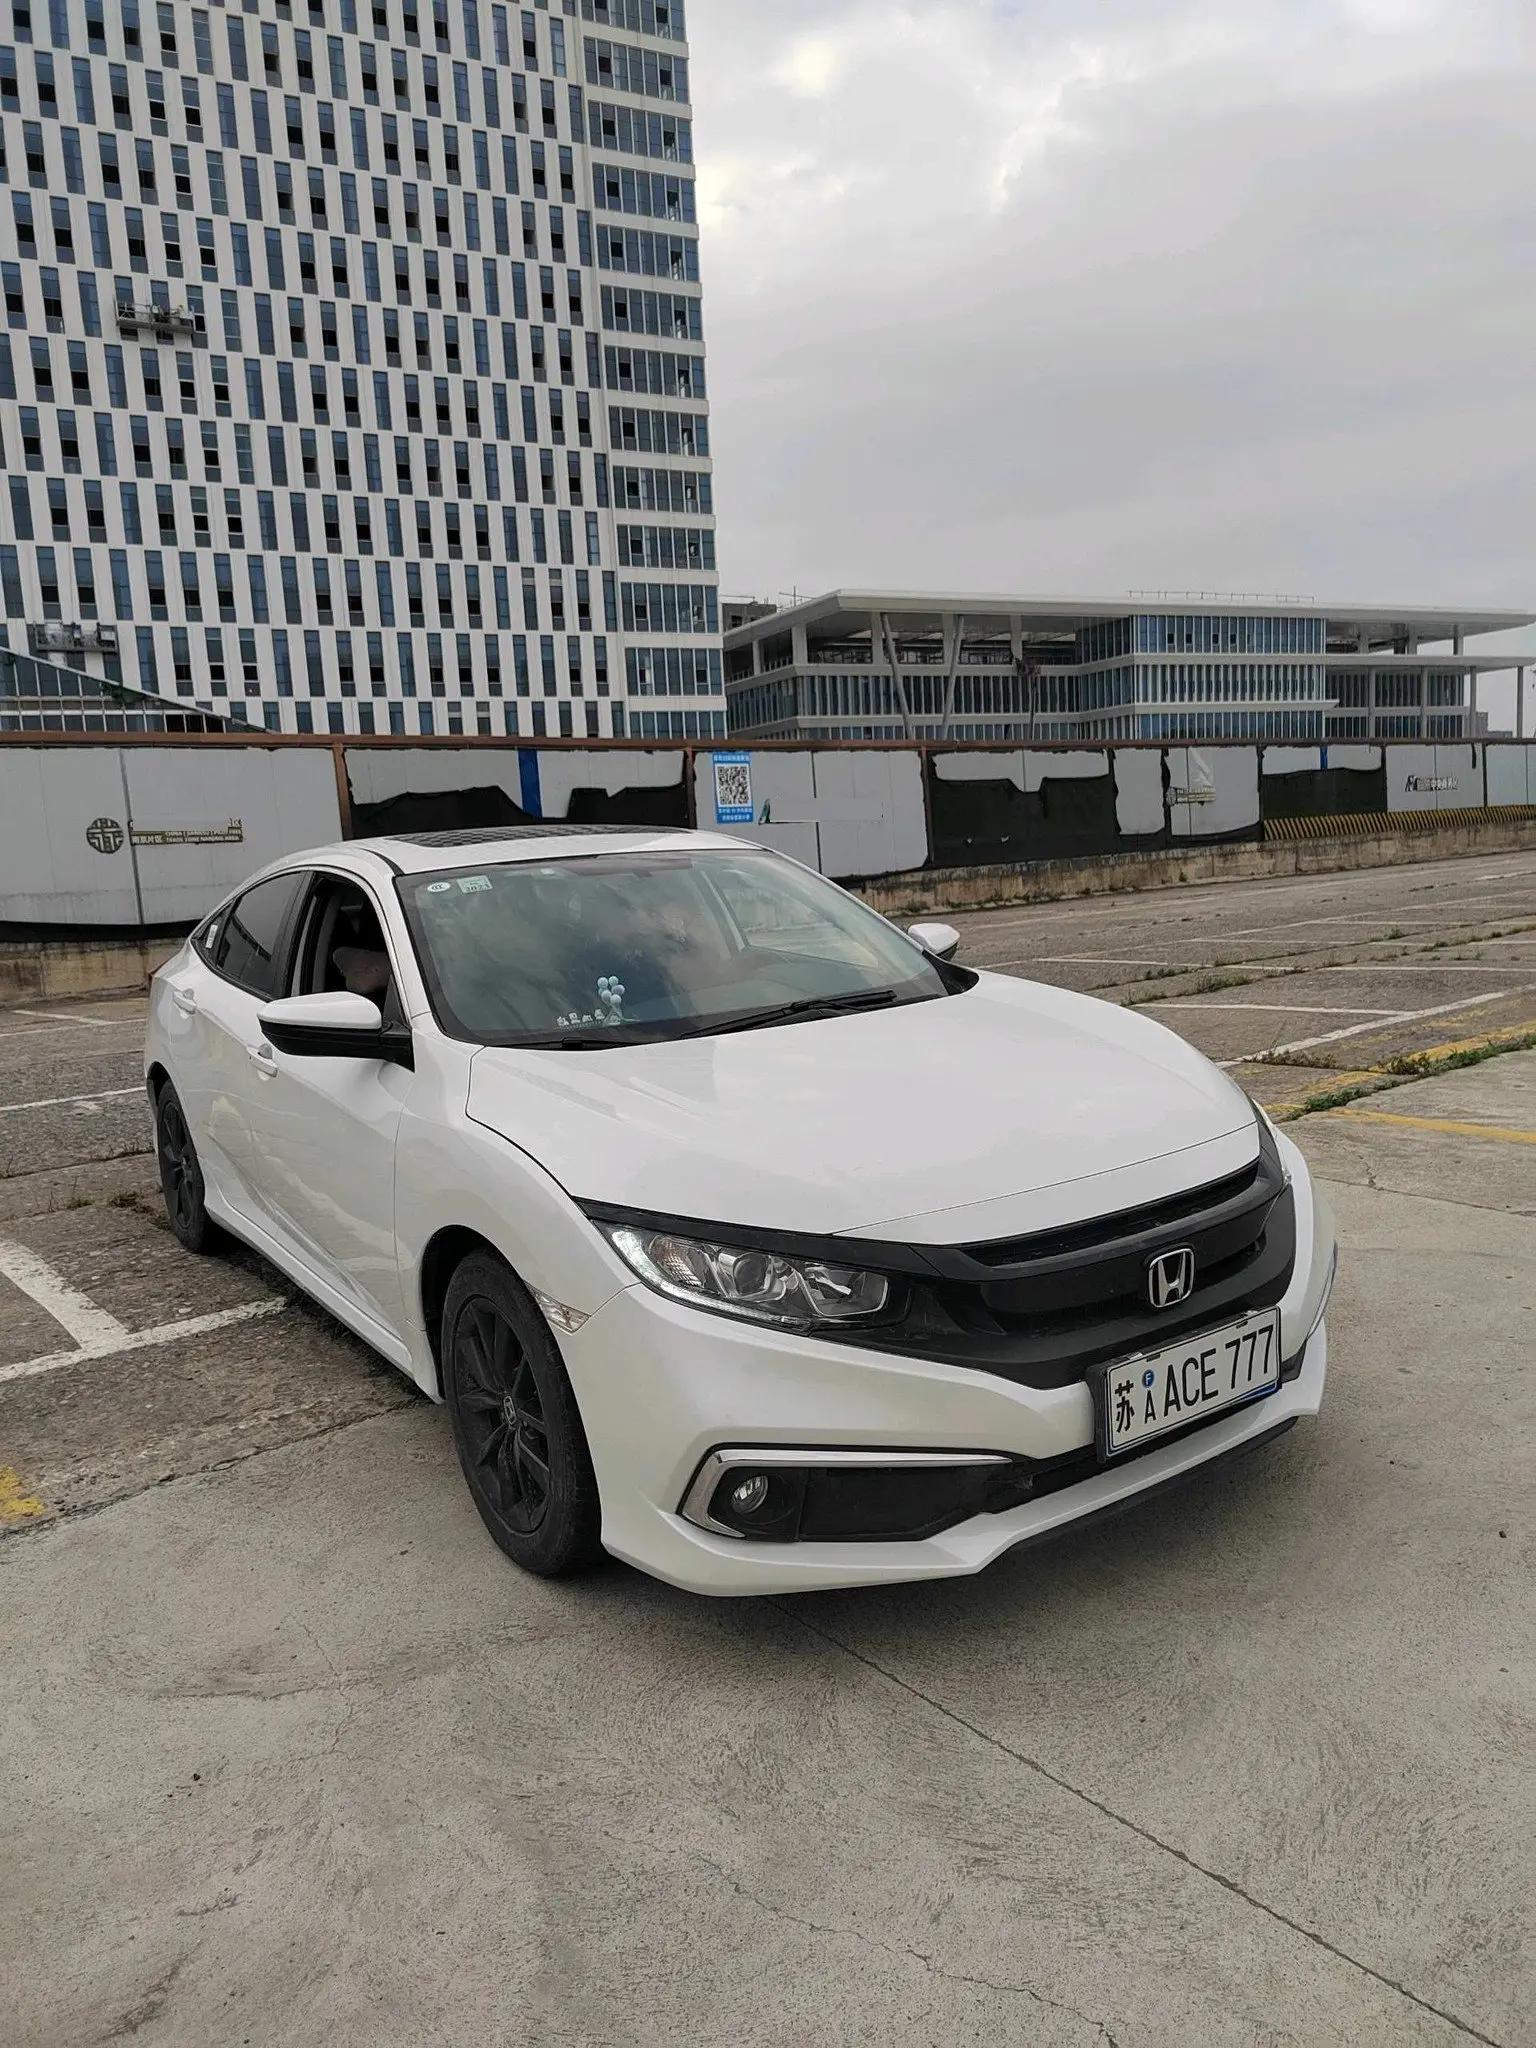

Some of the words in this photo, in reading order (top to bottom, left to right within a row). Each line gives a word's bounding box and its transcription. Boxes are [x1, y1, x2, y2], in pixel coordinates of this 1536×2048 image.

[1114, 1379, 1135, 1433] 苏
[1163, 1347, 1219, 1417] ACE
[1225, 1324, 1274, 1389] 777
